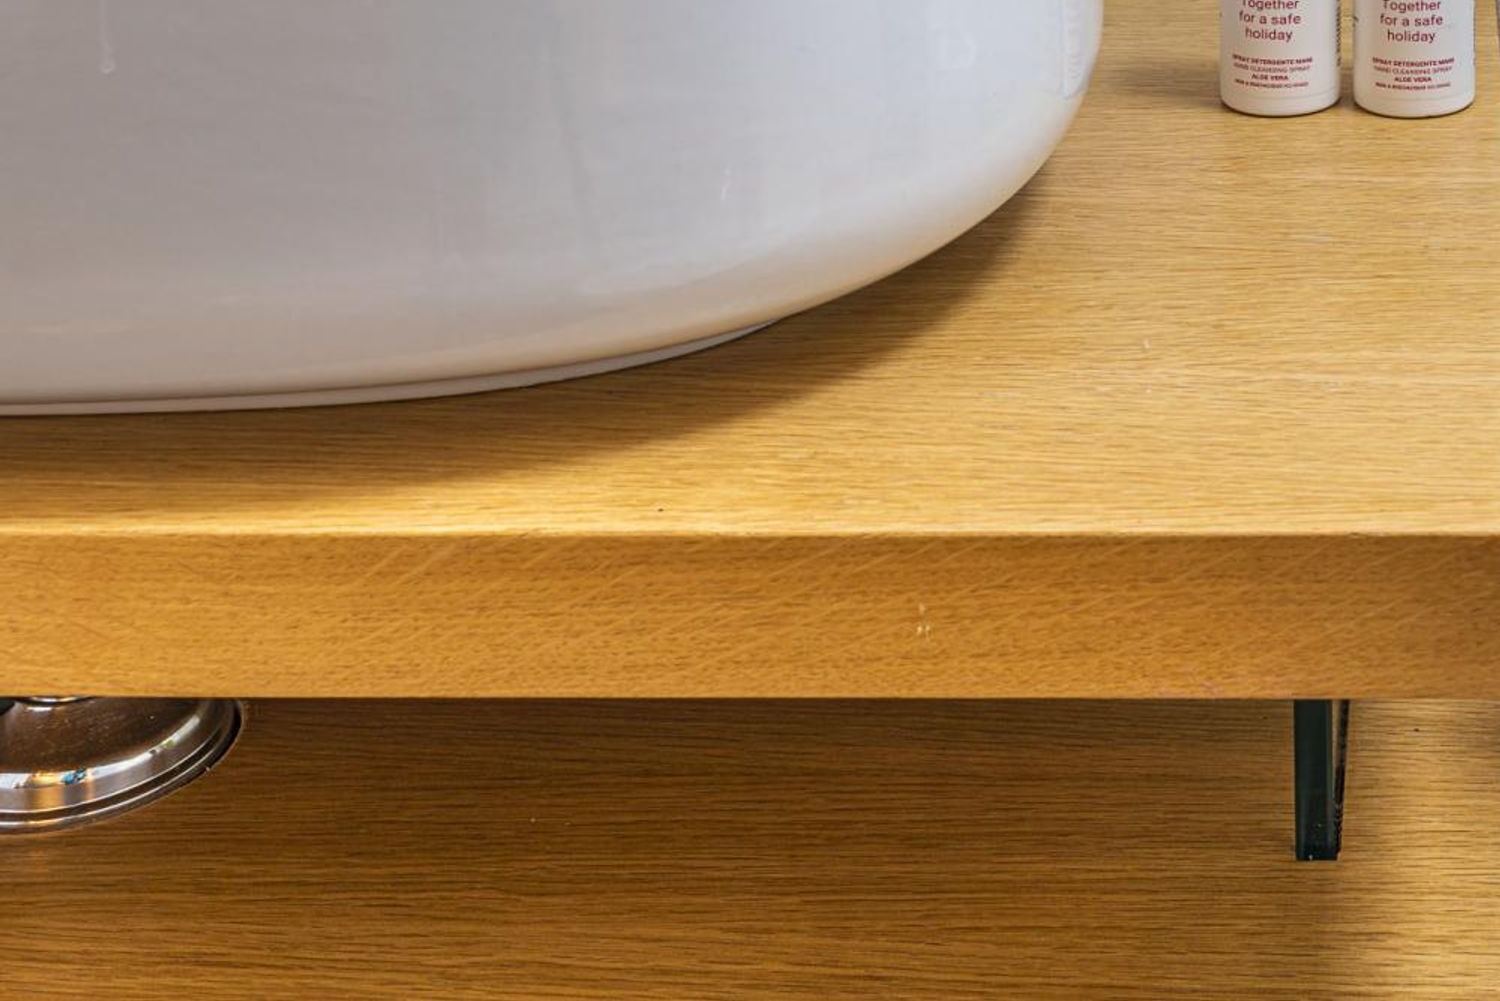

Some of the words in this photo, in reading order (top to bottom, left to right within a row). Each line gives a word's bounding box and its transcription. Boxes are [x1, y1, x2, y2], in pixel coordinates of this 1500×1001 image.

[1382, 0, 1441, 14] Together
[1239, 11, 1257, 23] for
[1260, 15, 1267, 24] a
[1271, 11, 1301, 25] safe
[1380, 13, 1398, 26] for
[1401, 18, 1409, 27] a
[1414, 14, 1443, 27] safe
[1245, 27, 1293, 42] holiday
[1387, 30, 1435, 43] holiday
